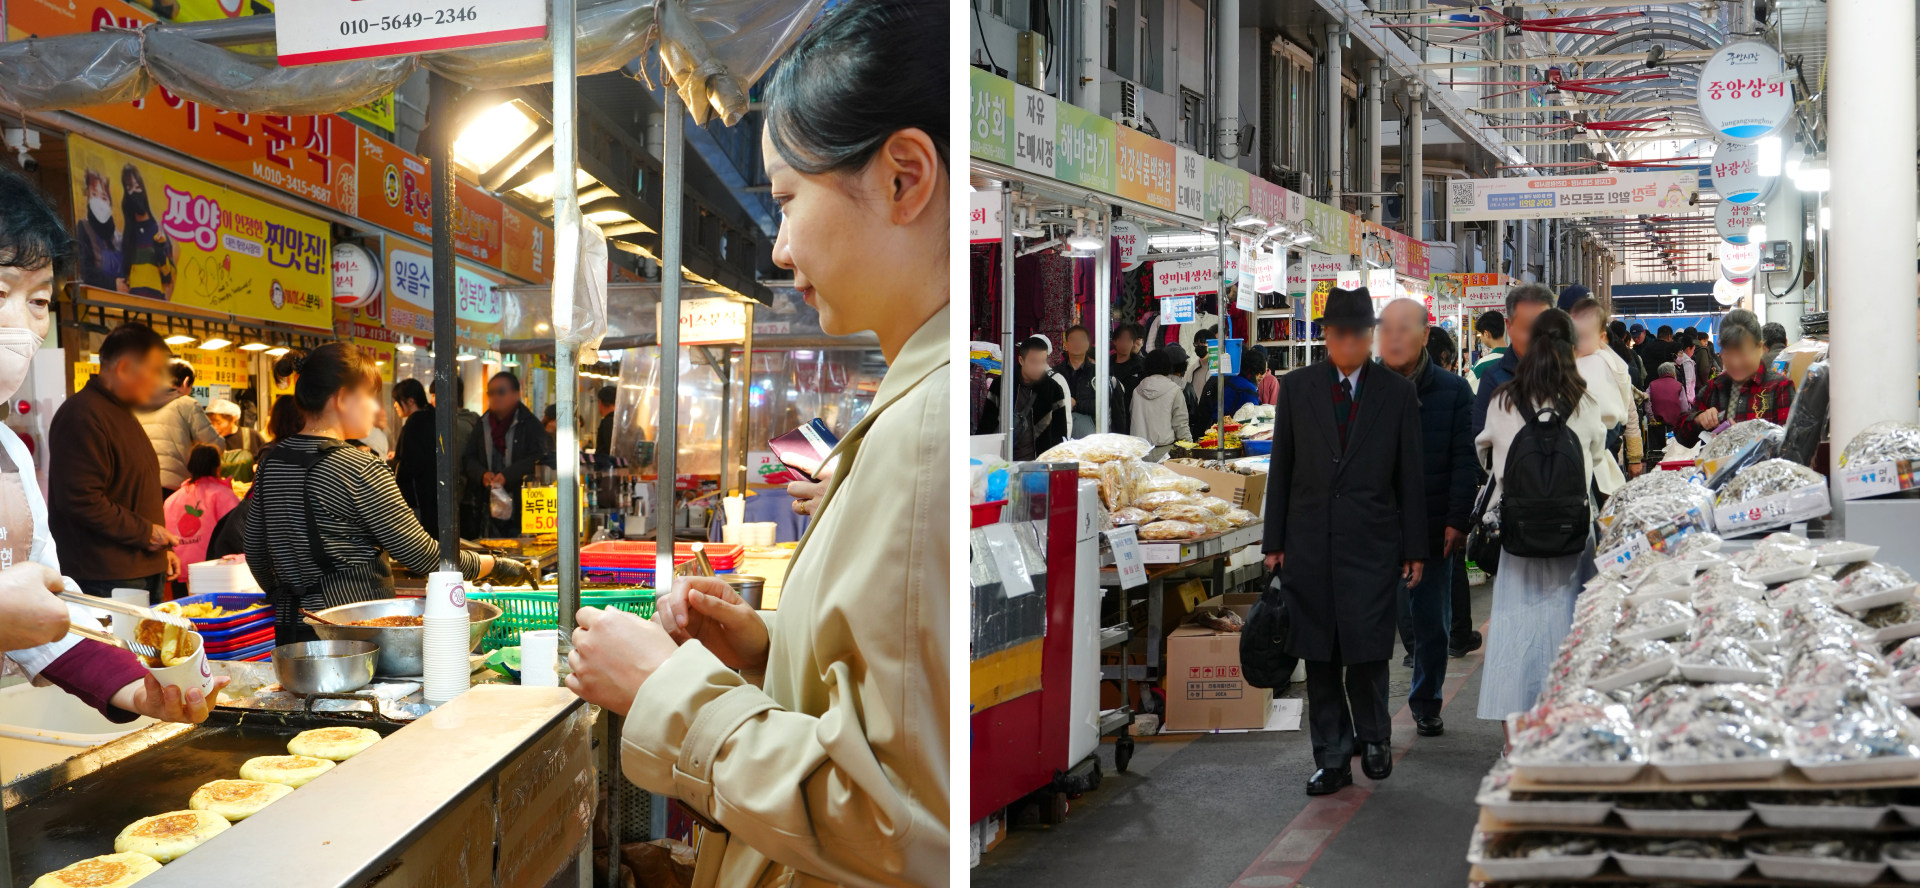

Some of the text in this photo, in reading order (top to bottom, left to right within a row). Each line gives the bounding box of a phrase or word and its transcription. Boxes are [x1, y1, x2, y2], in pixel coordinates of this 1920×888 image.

[340, 5, 477, 36] 010-5649-2346
[1725, 52, 1760, 65] 중앙시장
[1026, 94, 1045, 126] 자유
[1017, 131, 1054, 169] 도매시장
[1060, 122, 1110, 177] 해바라기
[1120, 145, 1171, 194] 건강식품백화점
[1184, 155, 1196, 179] 자유
[1715, 158, 1755, 179] 남광상
[252, 161, 332, 204] M.010-3415-9687
[1179, 185, 1202, 212] 도매시장
[1730, 205, 1751, 216] 삼양
[234, 213, 263, 240] 인정한
[265, 220, 327, 275] 찐맛집!
[530, 226, 544, 274] 칠
[395, 260, 431, 299] 잊을수
[1159, 268, 1213, 285] 영미네생선
[459, 276, 487, 314] 행복한
[1670, 297, 1685, 310] 15
[679, 309, 739, 329] 이스분식
[525, 499, 544, 514] 녹두
[526, 490, 544, 498] 100%
